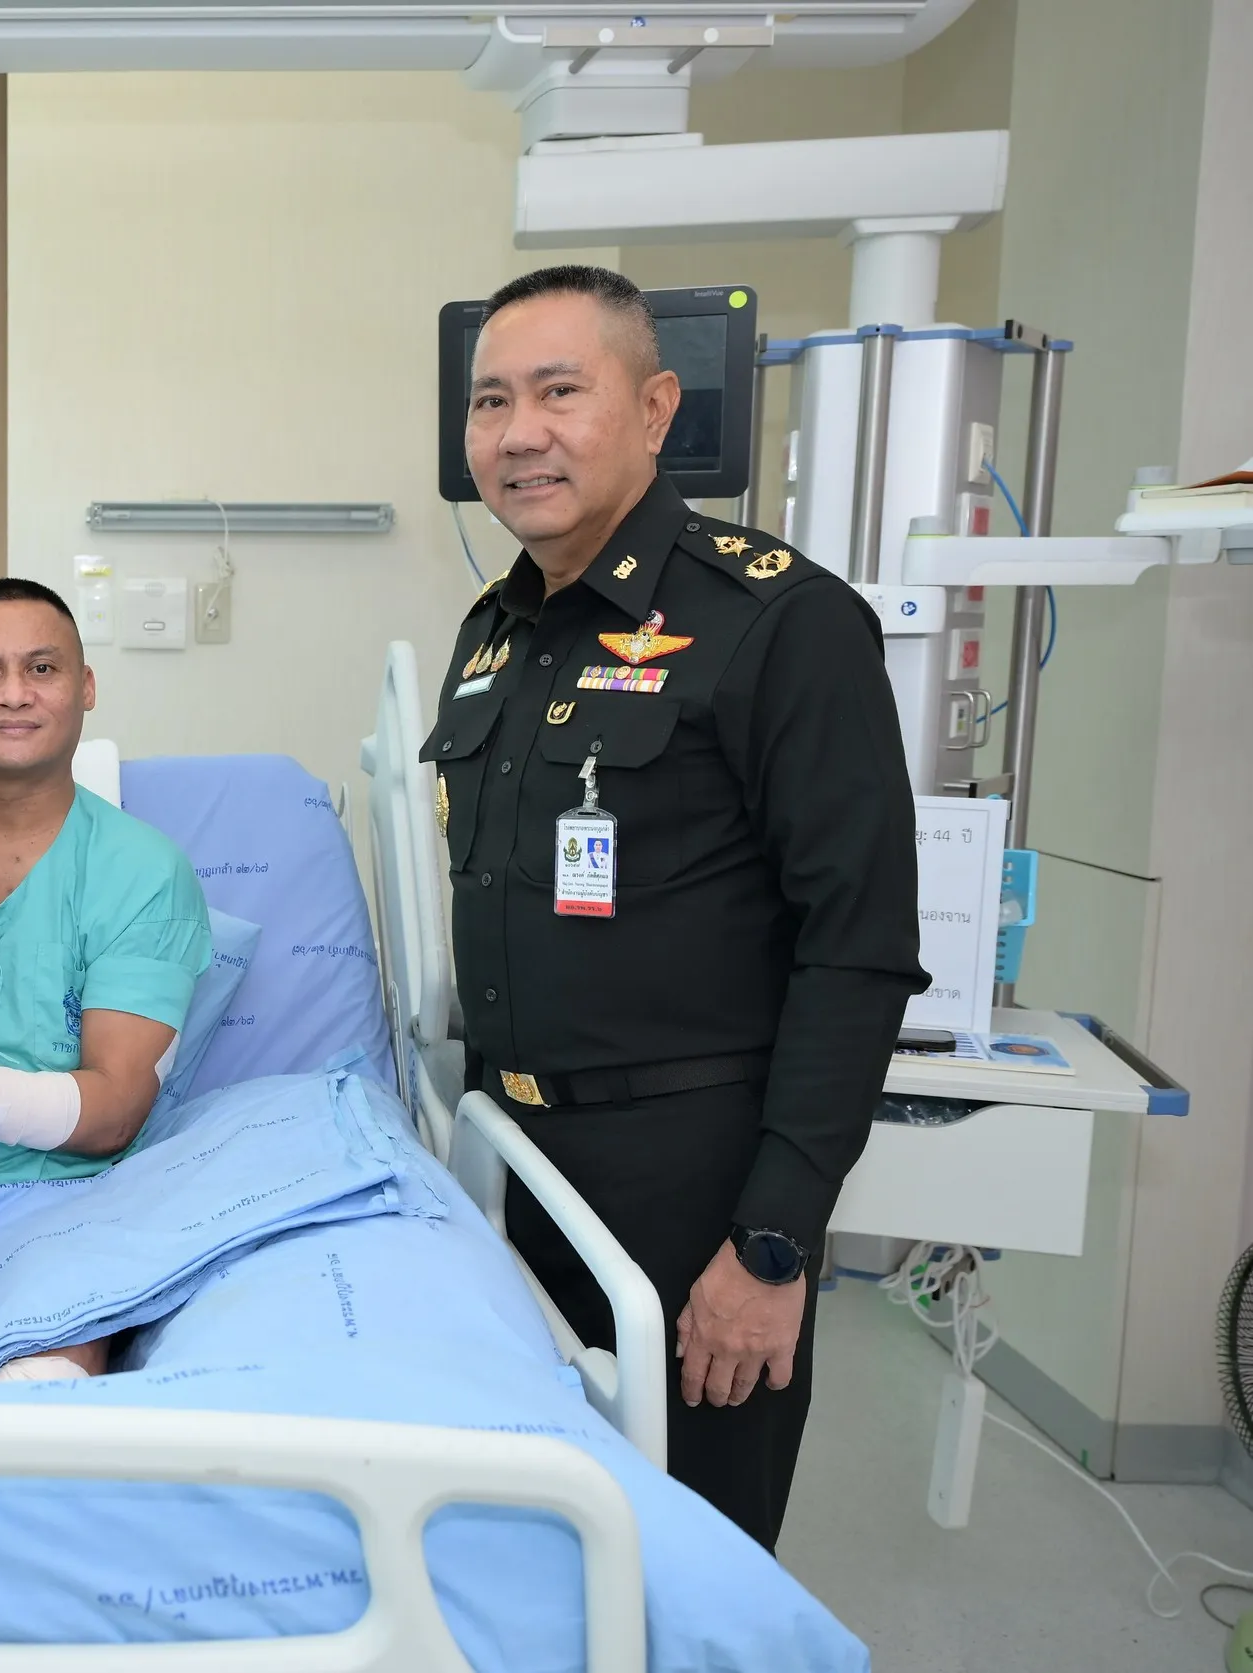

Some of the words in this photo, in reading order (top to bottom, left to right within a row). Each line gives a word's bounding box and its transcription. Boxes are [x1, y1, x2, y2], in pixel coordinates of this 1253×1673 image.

[933, 829, 951, 842] 44
[961, 827, 973, 844] ปี
[922, 987, 961, 999] ยขาด
